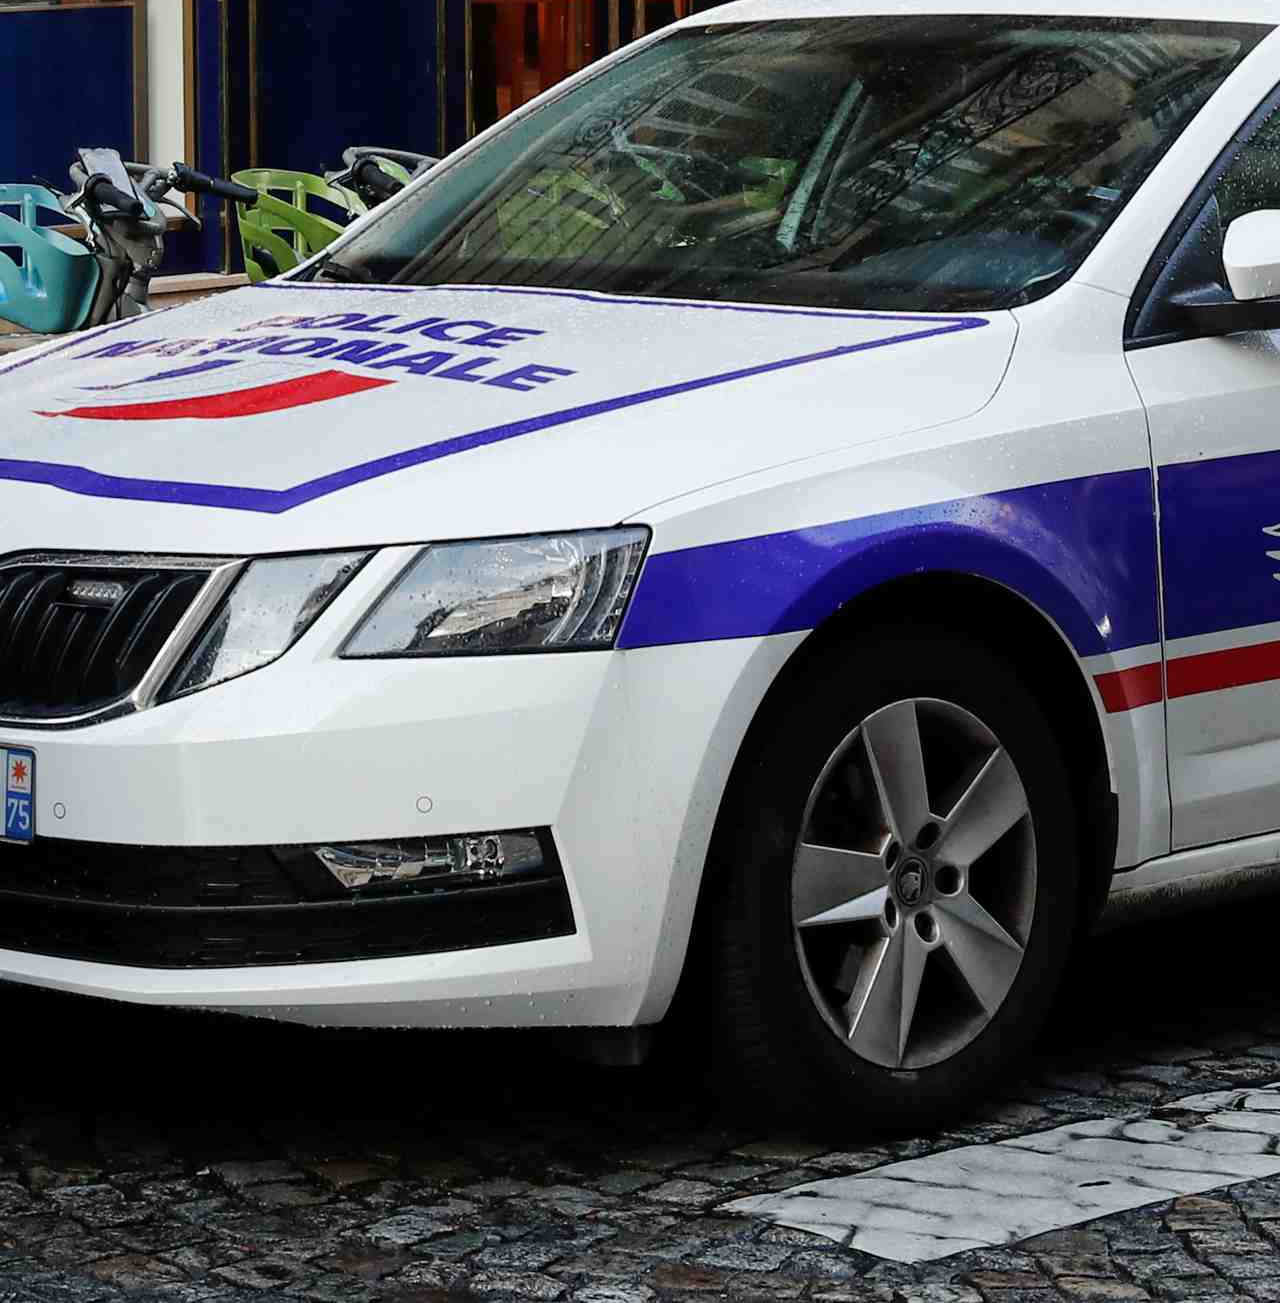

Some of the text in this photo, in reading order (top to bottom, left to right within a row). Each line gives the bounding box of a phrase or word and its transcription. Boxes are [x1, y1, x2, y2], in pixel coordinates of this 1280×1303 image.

[237, 312, 548, 348] POLICE
[70, 334, 577, 392] NATIONALE
[7, 799, 30, 831] 75
